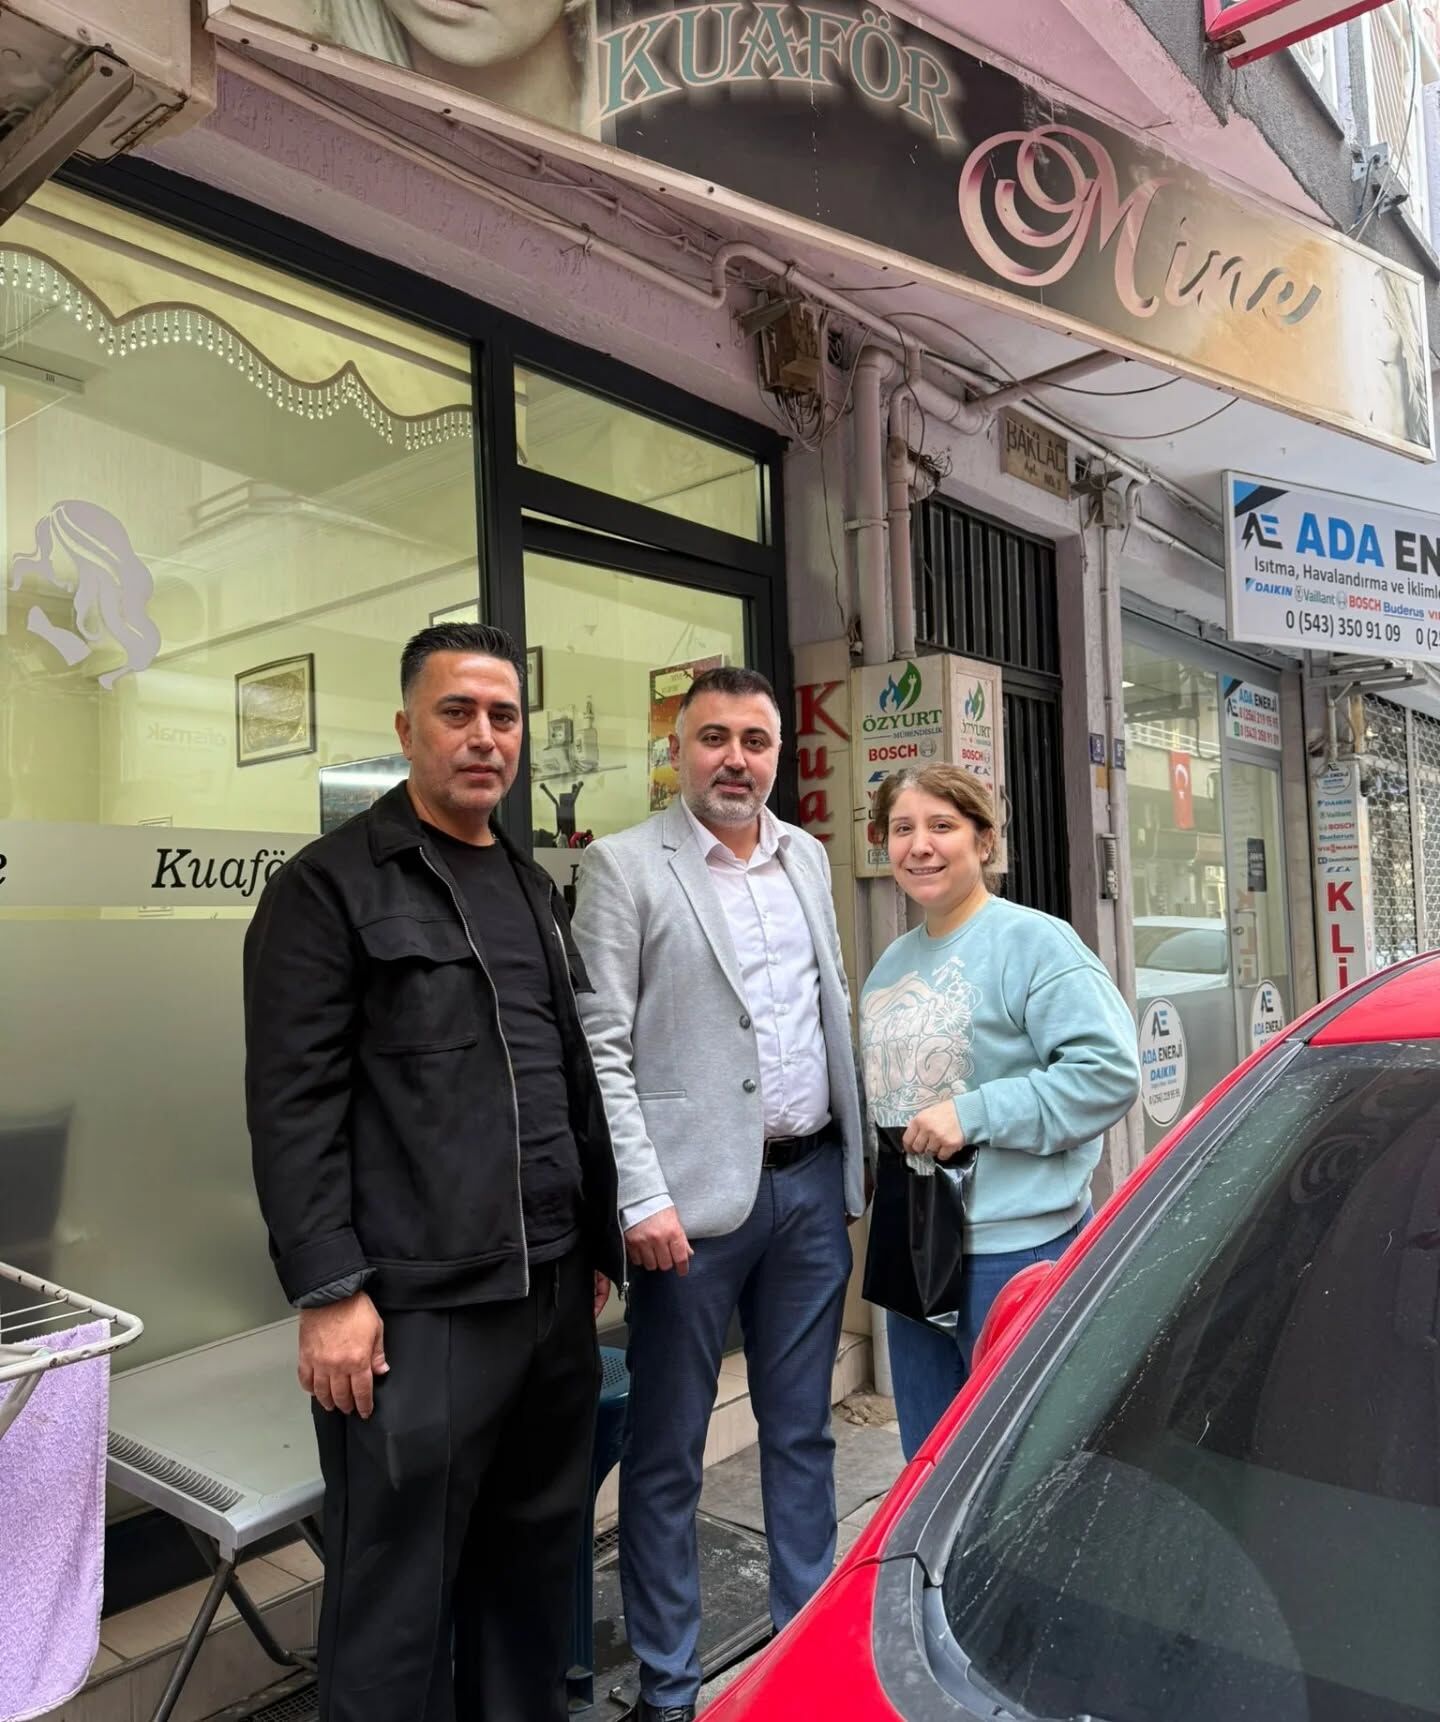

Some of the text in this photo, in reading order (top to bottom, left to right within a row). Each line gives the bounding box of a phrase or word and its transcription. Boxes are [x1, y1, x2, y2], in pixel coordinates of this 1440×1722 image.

[594, 2, 957, 142] KUAFÖR
[958, 123, 1322, 326] Mine
[1296, 511, 1440, 577] ADA EN
[1254, 556, 1300, 581] Isıtma,
[1303, 563, 1388, 592] Havalandırma
[1391, 582, 1405, 594] ve
[1255, 581, 1293, 597] DAIKIN
[1304, 589, 1336, 606] Vaillant
[1349, 595, 1382, 612] BOSCH
[1384, 601, 1424, 619] Buderus
[1286, 610, 1295, 629] 0
[1299, 611, 1335, 638] (543)
[1339, 617, 1363, 638] 350
[1366, 621, 1382, 640] 91
[1385, 624, 1401, 642] 09
[1416, 628, 1424, 646] 0
[863, 709, 943, 733] ÖZYURT
[868, 744, 918, 762] BOSCH
[961, 749, 984, 763] BOSCH
[1142, 1039, 1182, 1066] ADA ENERJİ
[1150, 1064, 1177, 1081] DAIKIN
